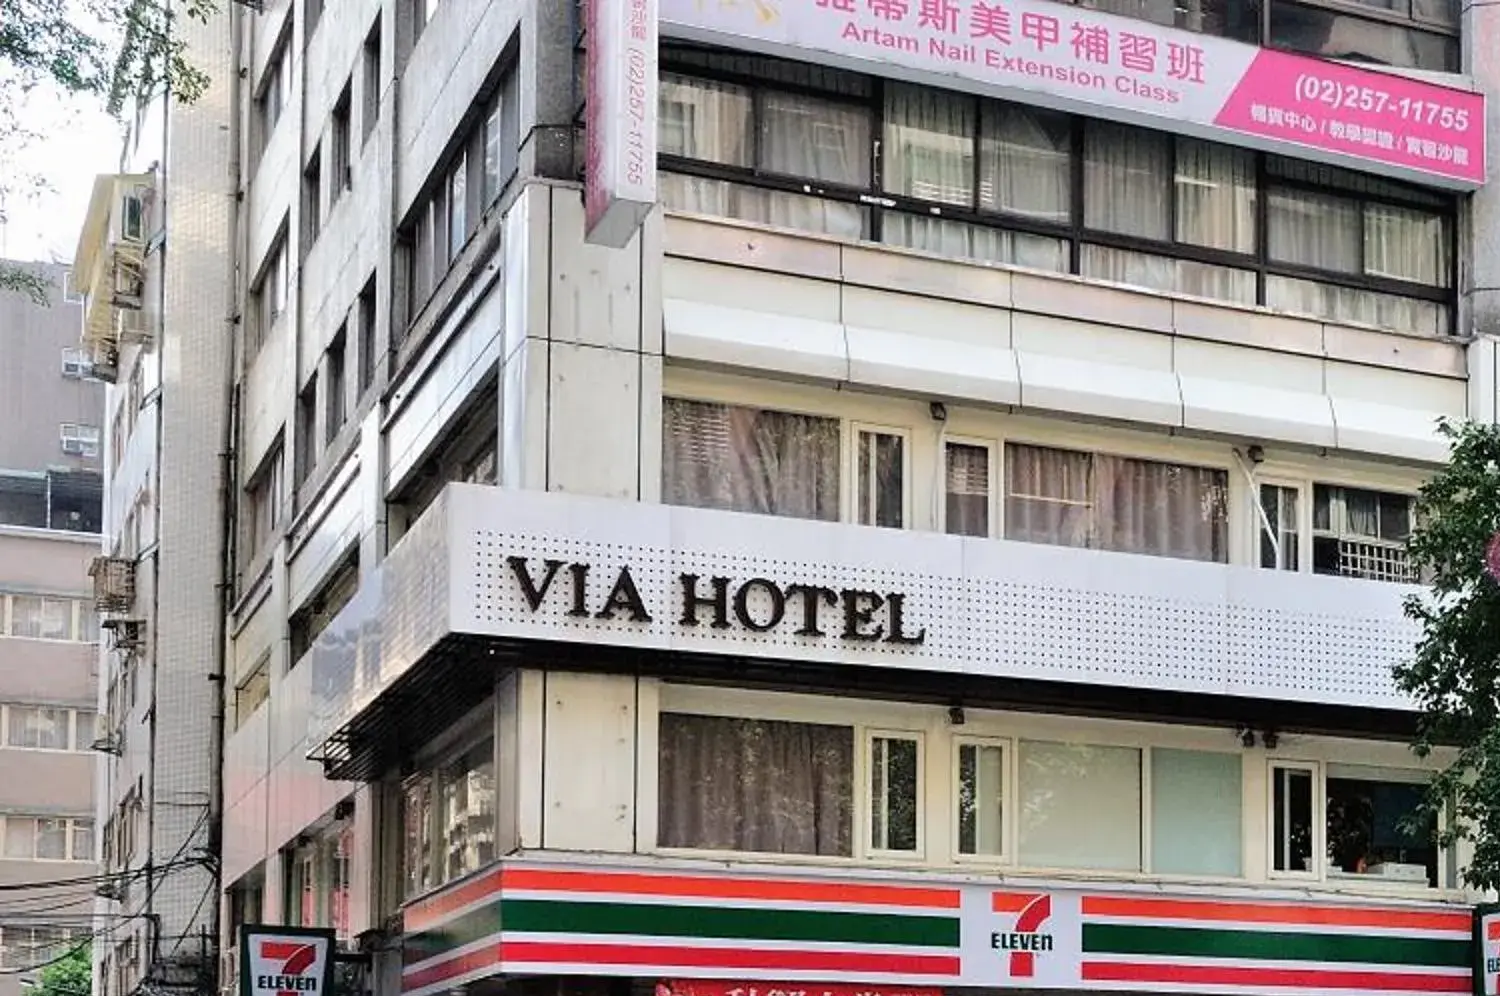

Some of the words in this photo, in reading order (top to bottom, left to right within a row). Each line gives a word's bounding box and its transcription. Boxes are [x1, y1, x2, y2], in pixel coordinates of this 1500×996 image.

[842, 21, 919, 53] Artam
[929, 37, 976, 64] Nail
[985, 49, 1106, 90] Extension
[1114, 75, 1180, 104] Class
[1295, 74, 1469, 131] (02)257-11755
[506, 555, 653, 623] VIA
[678, 571, 926, 646] HOTEL
